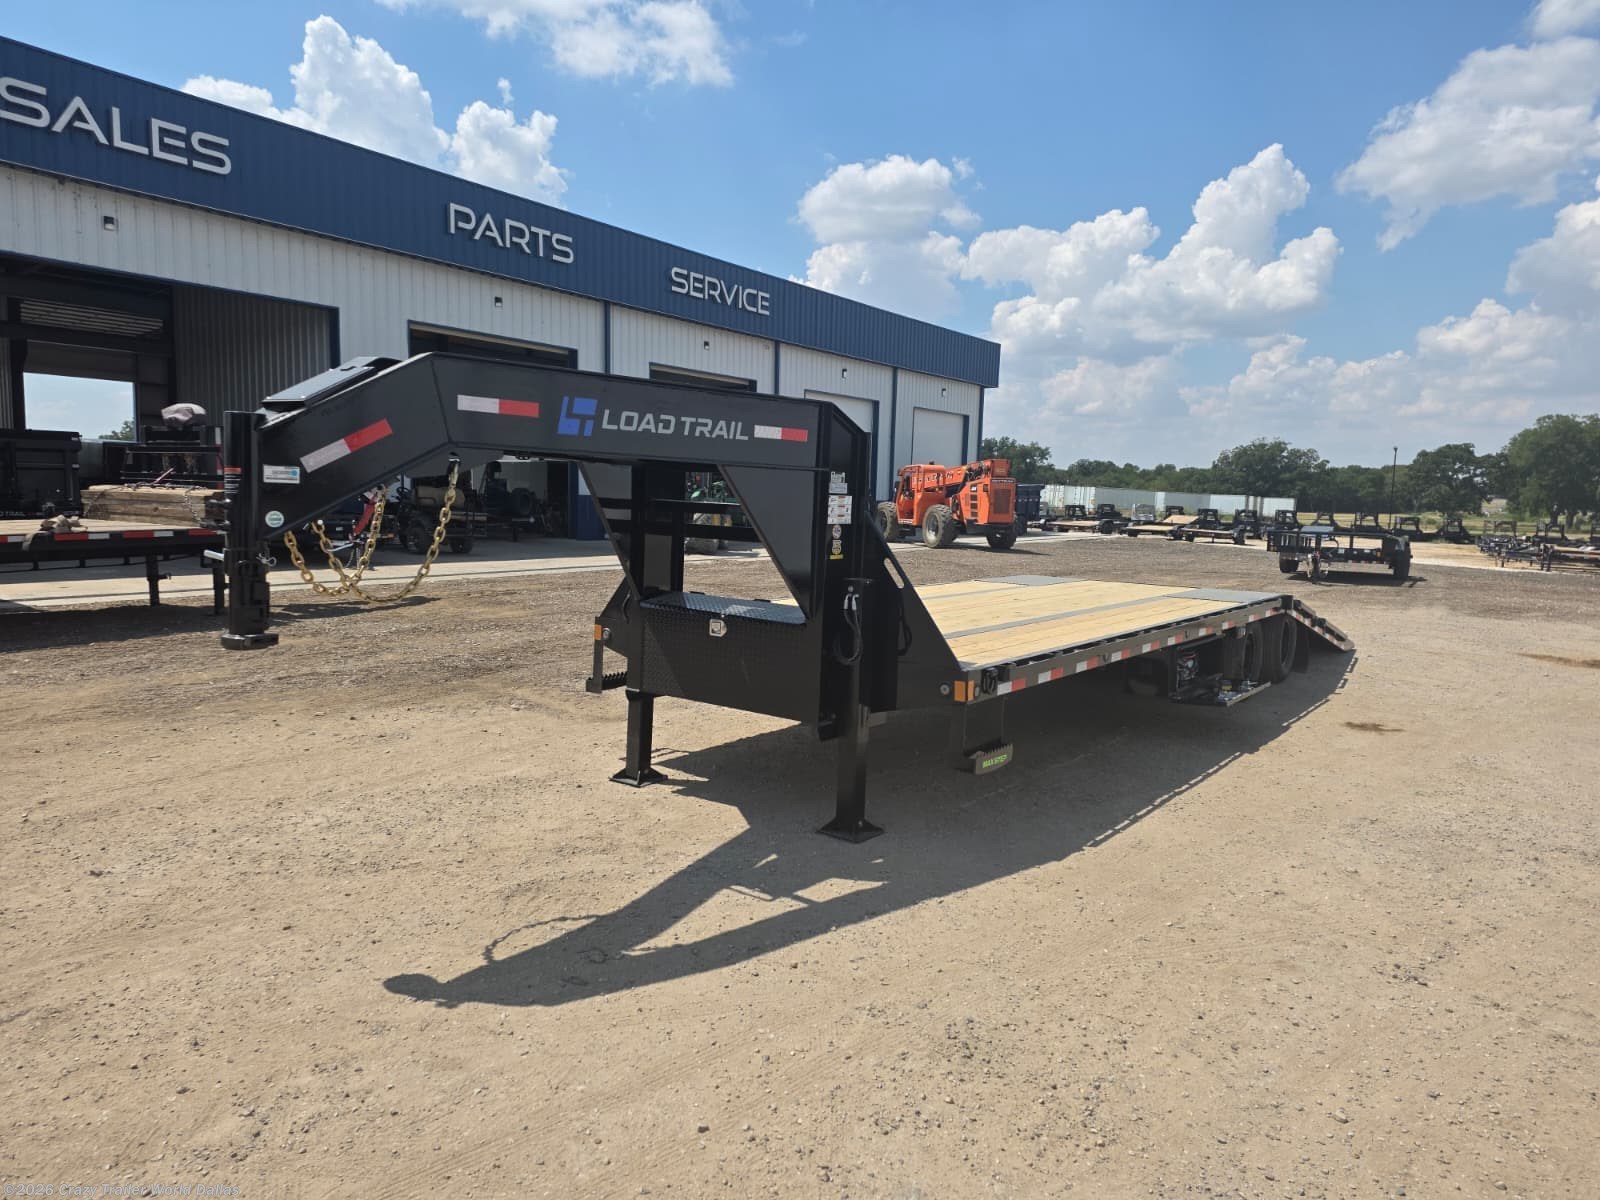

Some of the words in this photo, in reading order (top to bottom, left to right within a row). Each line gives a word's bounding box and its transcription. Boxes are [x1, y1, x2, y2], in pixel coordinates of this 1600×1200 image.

[0, 76, 232, 175] SALES
[449, 202, 574, 264] PARTS
[671, 266, 770, 316] SERVICE
[601, 408, 675, 435] LOAD
[680, 416, 749, 441] TRAIL
